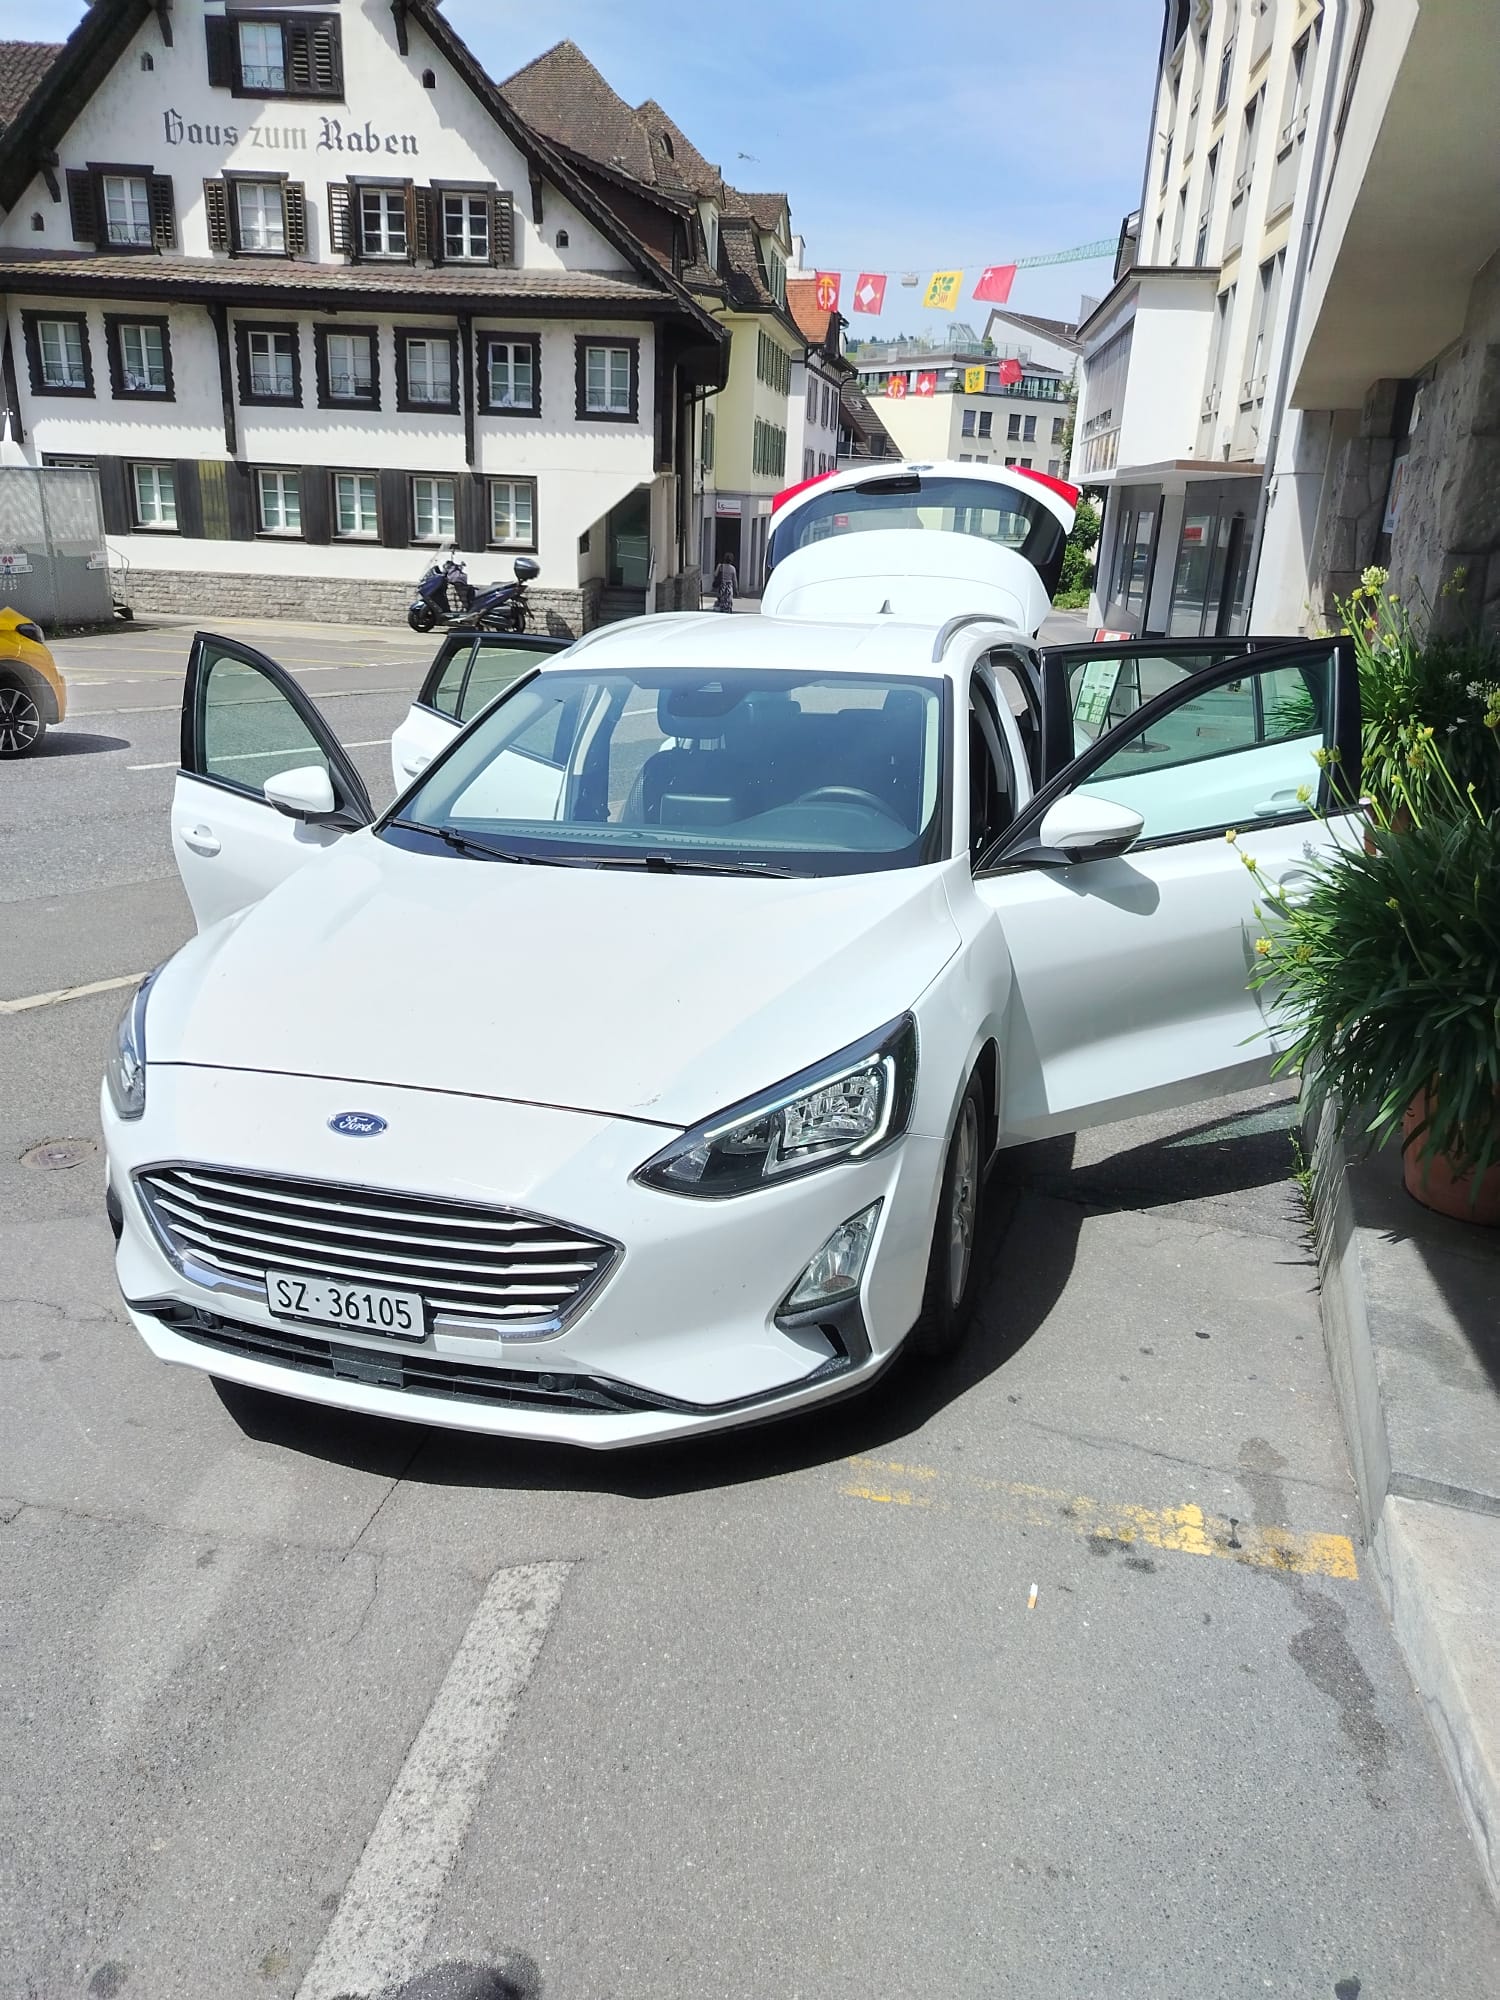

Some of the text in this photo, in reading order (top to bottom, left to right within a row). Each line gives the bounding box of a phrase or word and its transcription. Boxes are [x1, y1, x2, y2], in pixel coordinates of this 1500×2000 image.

[163, 107, 419, 156] Haus zum Raben
[339, 1115, 375, 1132] Ford
